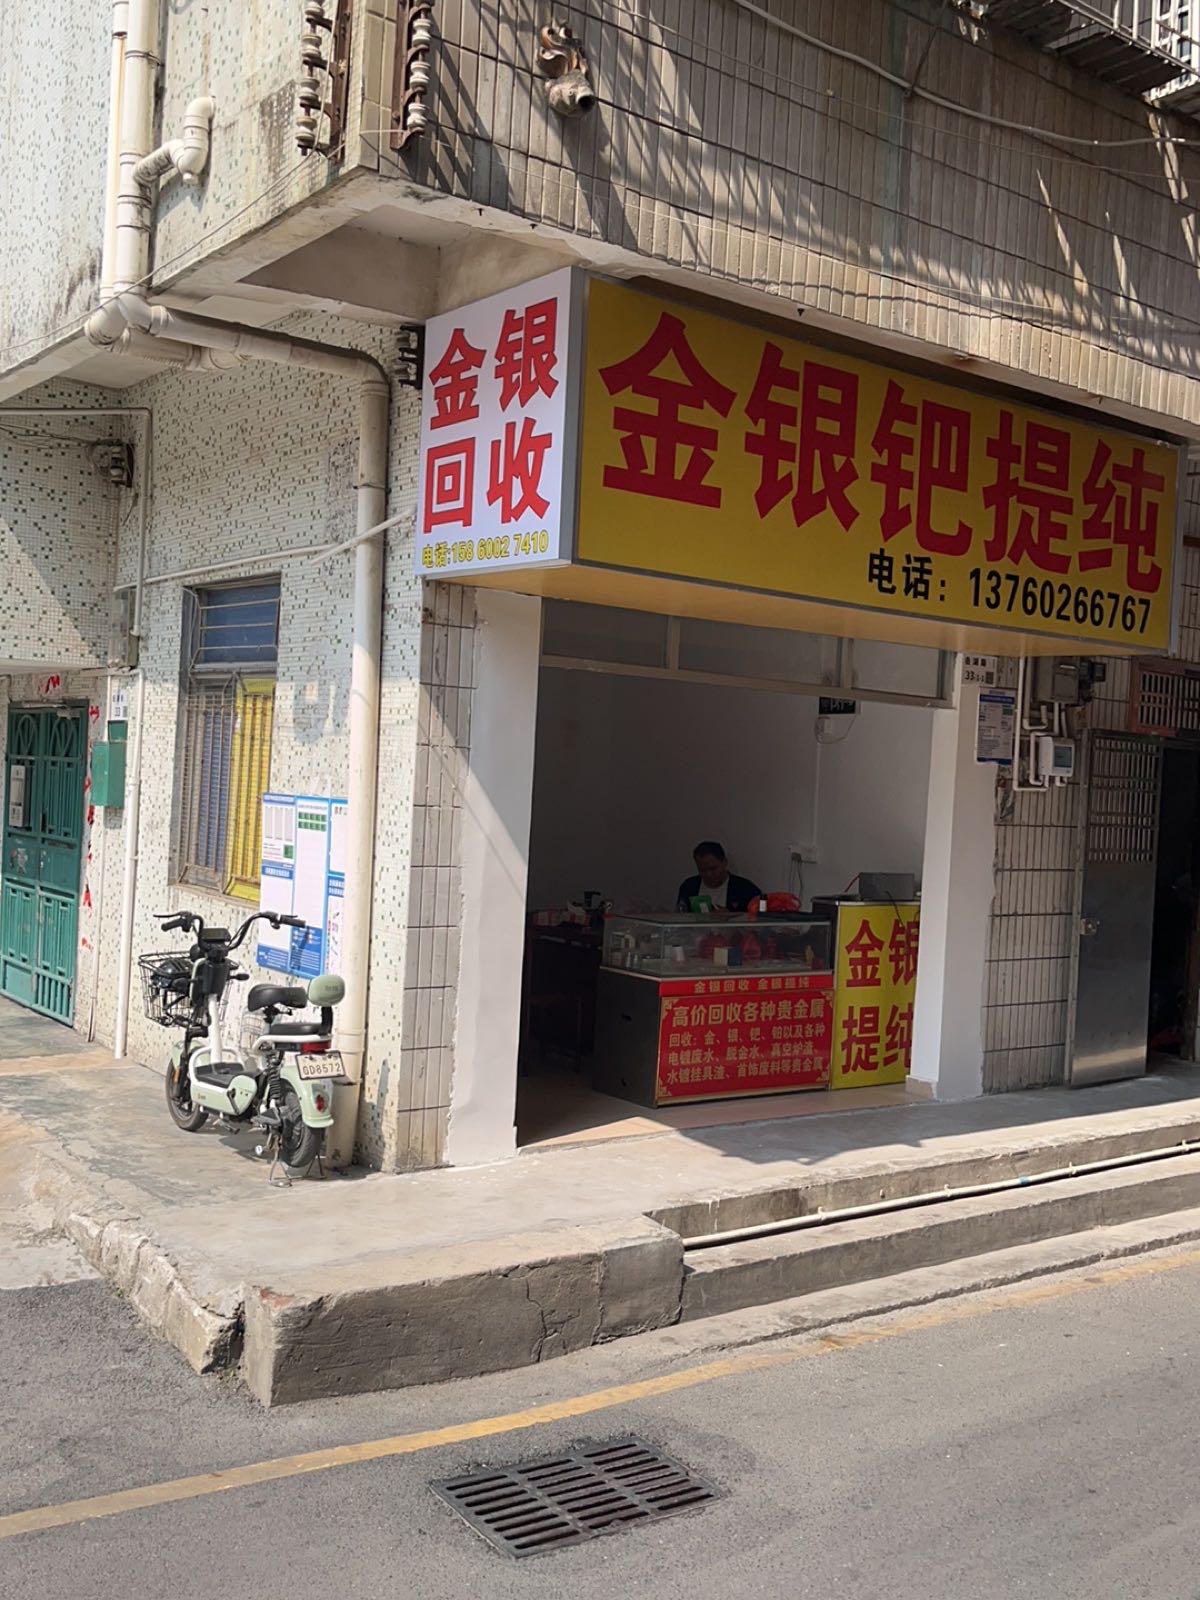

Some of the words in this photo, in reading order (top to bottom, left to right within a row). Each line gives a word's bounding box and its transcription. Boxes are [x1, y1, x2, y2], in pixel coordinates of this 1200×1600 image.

[428, 297, 558, 431] 金银
[423, 416, 552, 534] 回收
[599, 311, 1165, 594] 金银钯提纯
[477, 535, 510, 560] 6002
[513, 529, 549, 556] 7410
[672, 998, 825, 1027] 高价回收各种贵金属
